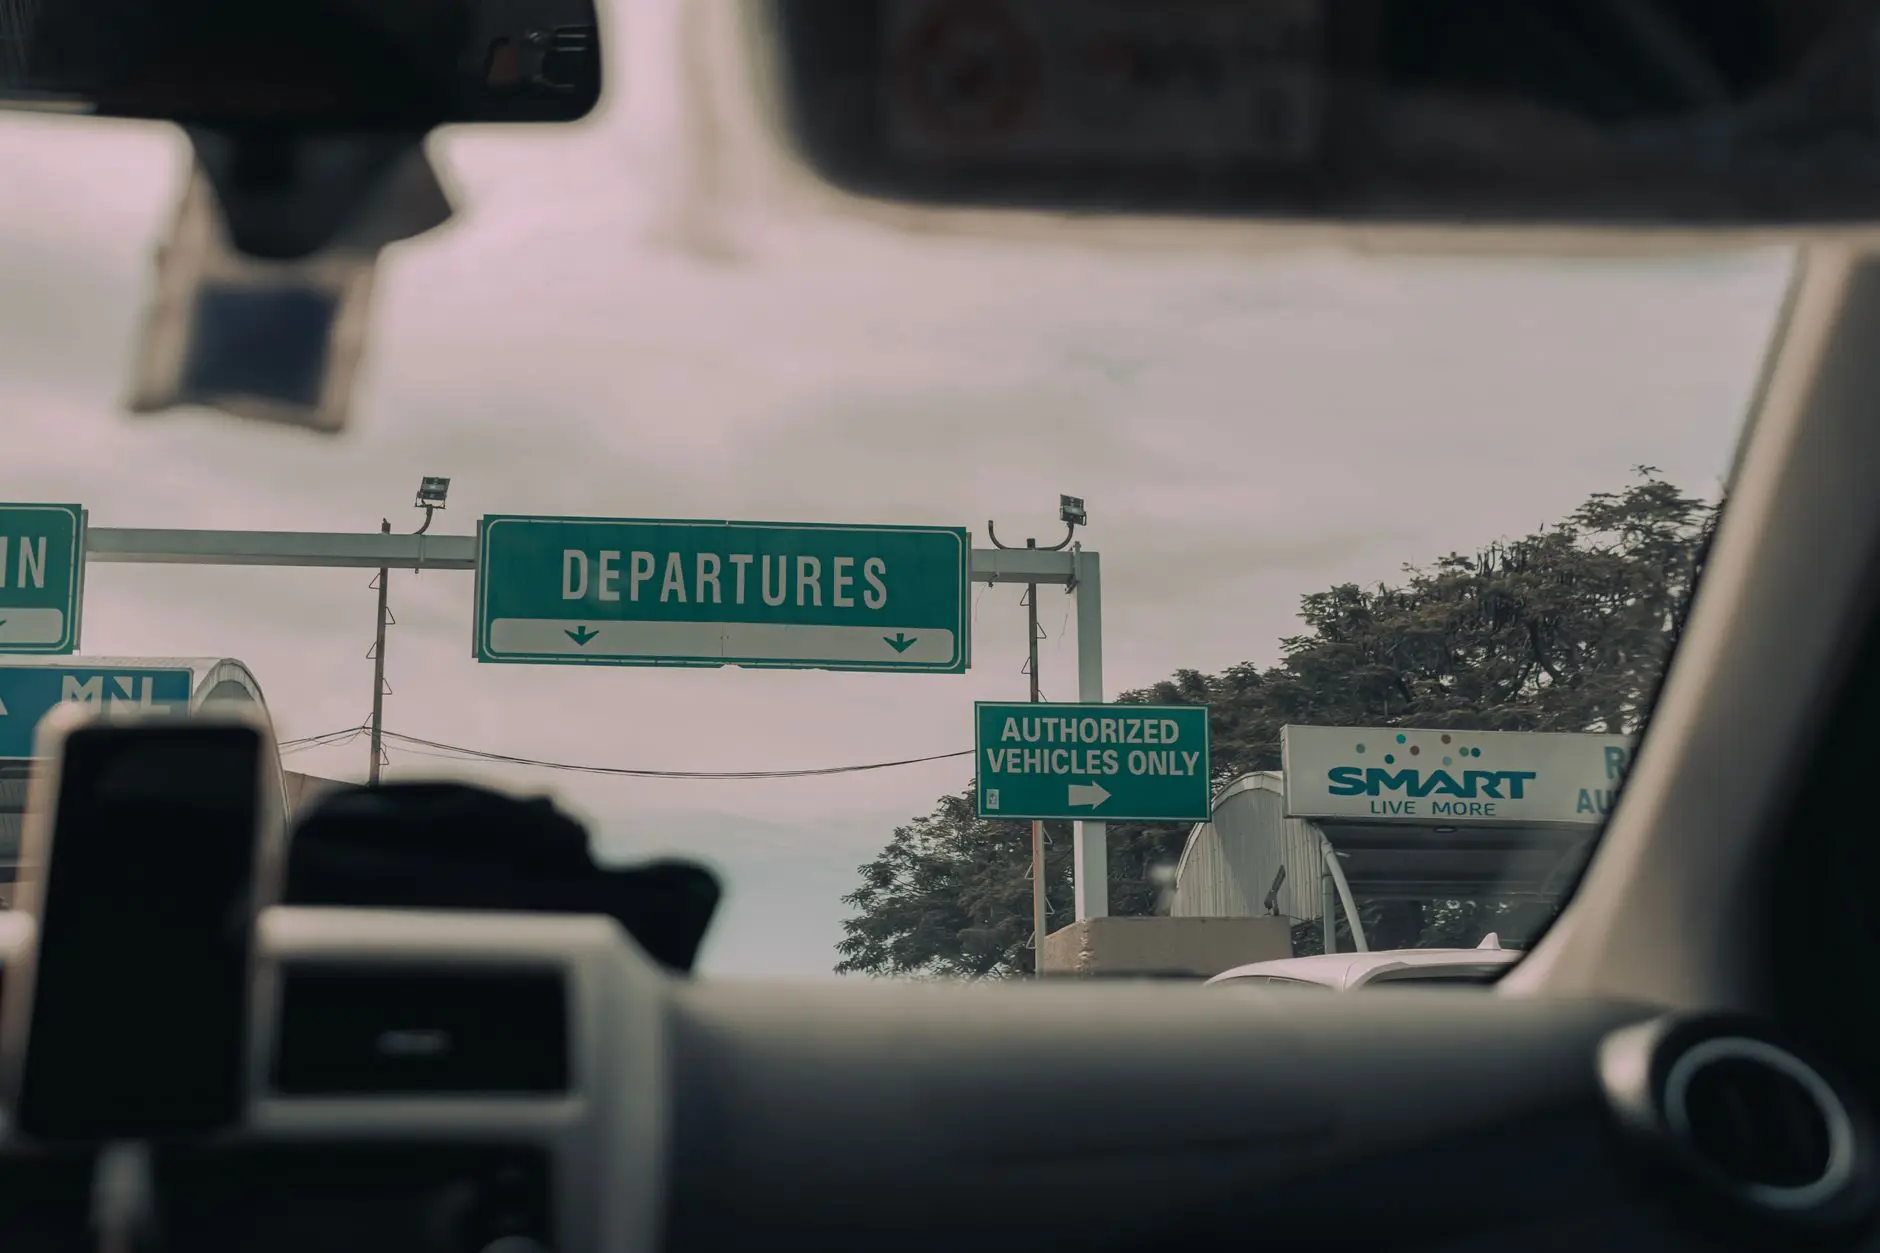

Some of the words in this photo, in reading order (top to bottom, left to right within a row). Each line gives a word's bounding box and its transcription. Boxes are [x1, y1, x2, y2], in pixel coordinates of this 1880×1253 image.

[562, 549, 887, 610] DEPARTURES
[1001, 717, 1180, 744] AUTHORIZED
[986, 748, 1119, 774] VEHICLES
[1127, 750, 1200, 776] ONLY
[1327, 767, 1537, 799] SMART
[1370, 800, 1417, 815] LIVE
[1431, 801, 1497, 817] MORE
[1576, 788, 1614, 815] AU
